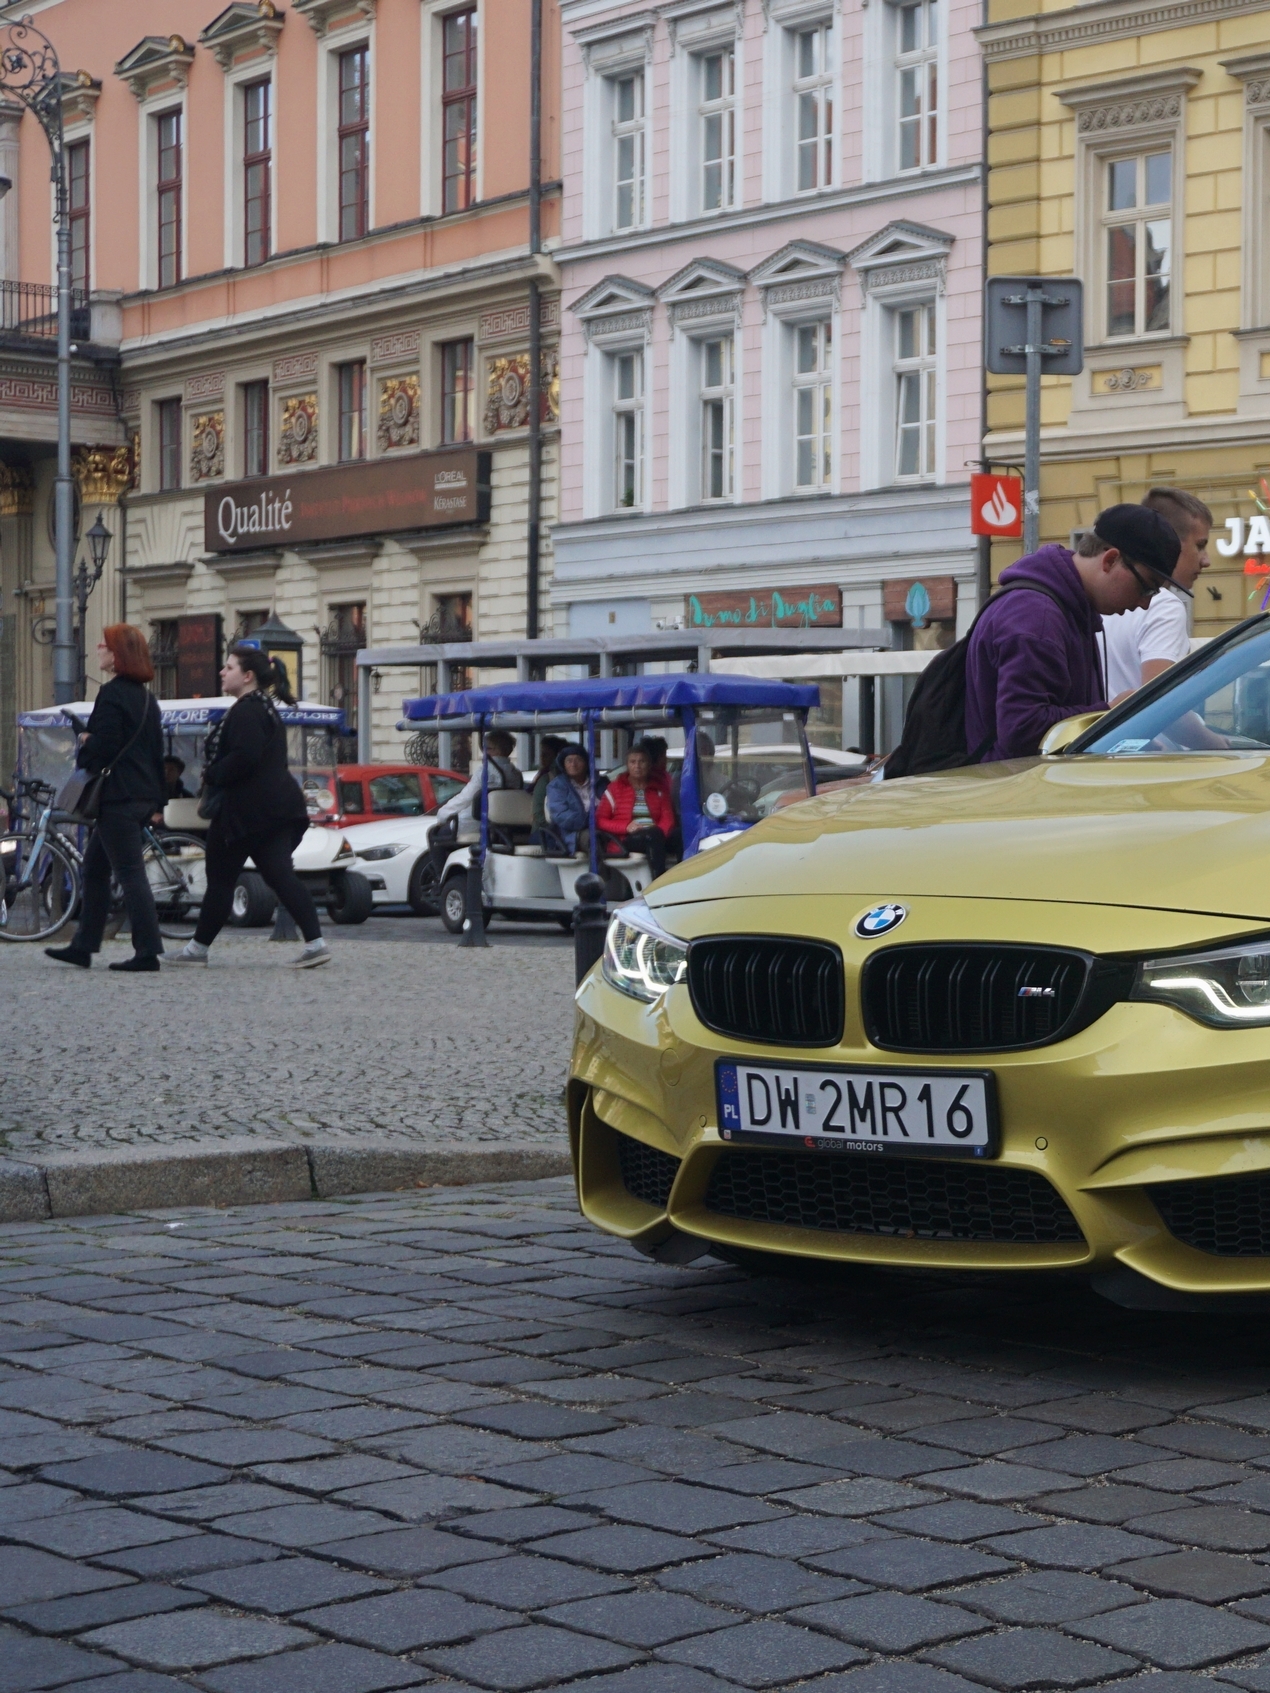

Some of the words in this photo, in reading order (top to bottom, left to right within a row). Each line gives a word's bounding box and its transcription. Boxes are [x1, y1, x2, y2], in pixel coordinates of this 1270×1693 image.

[217, 488, 293, 544] Qualité
[745, 597, 769, 622] di
[772, 591, 835, 628] Puglia
[161, 709, 209, 722] PLORE
[279, 711, 339, 719] EXPLORE
[1024, 986, 1056, 997] M4
[723, 1103, 739, 1120] PL
[746, 1072, 800, 1130] DW
[818, 1078, 974, 1138] 2MR16
[817, 1138, 844, 1150] global
[846, 1141, 884, 1152] motors
